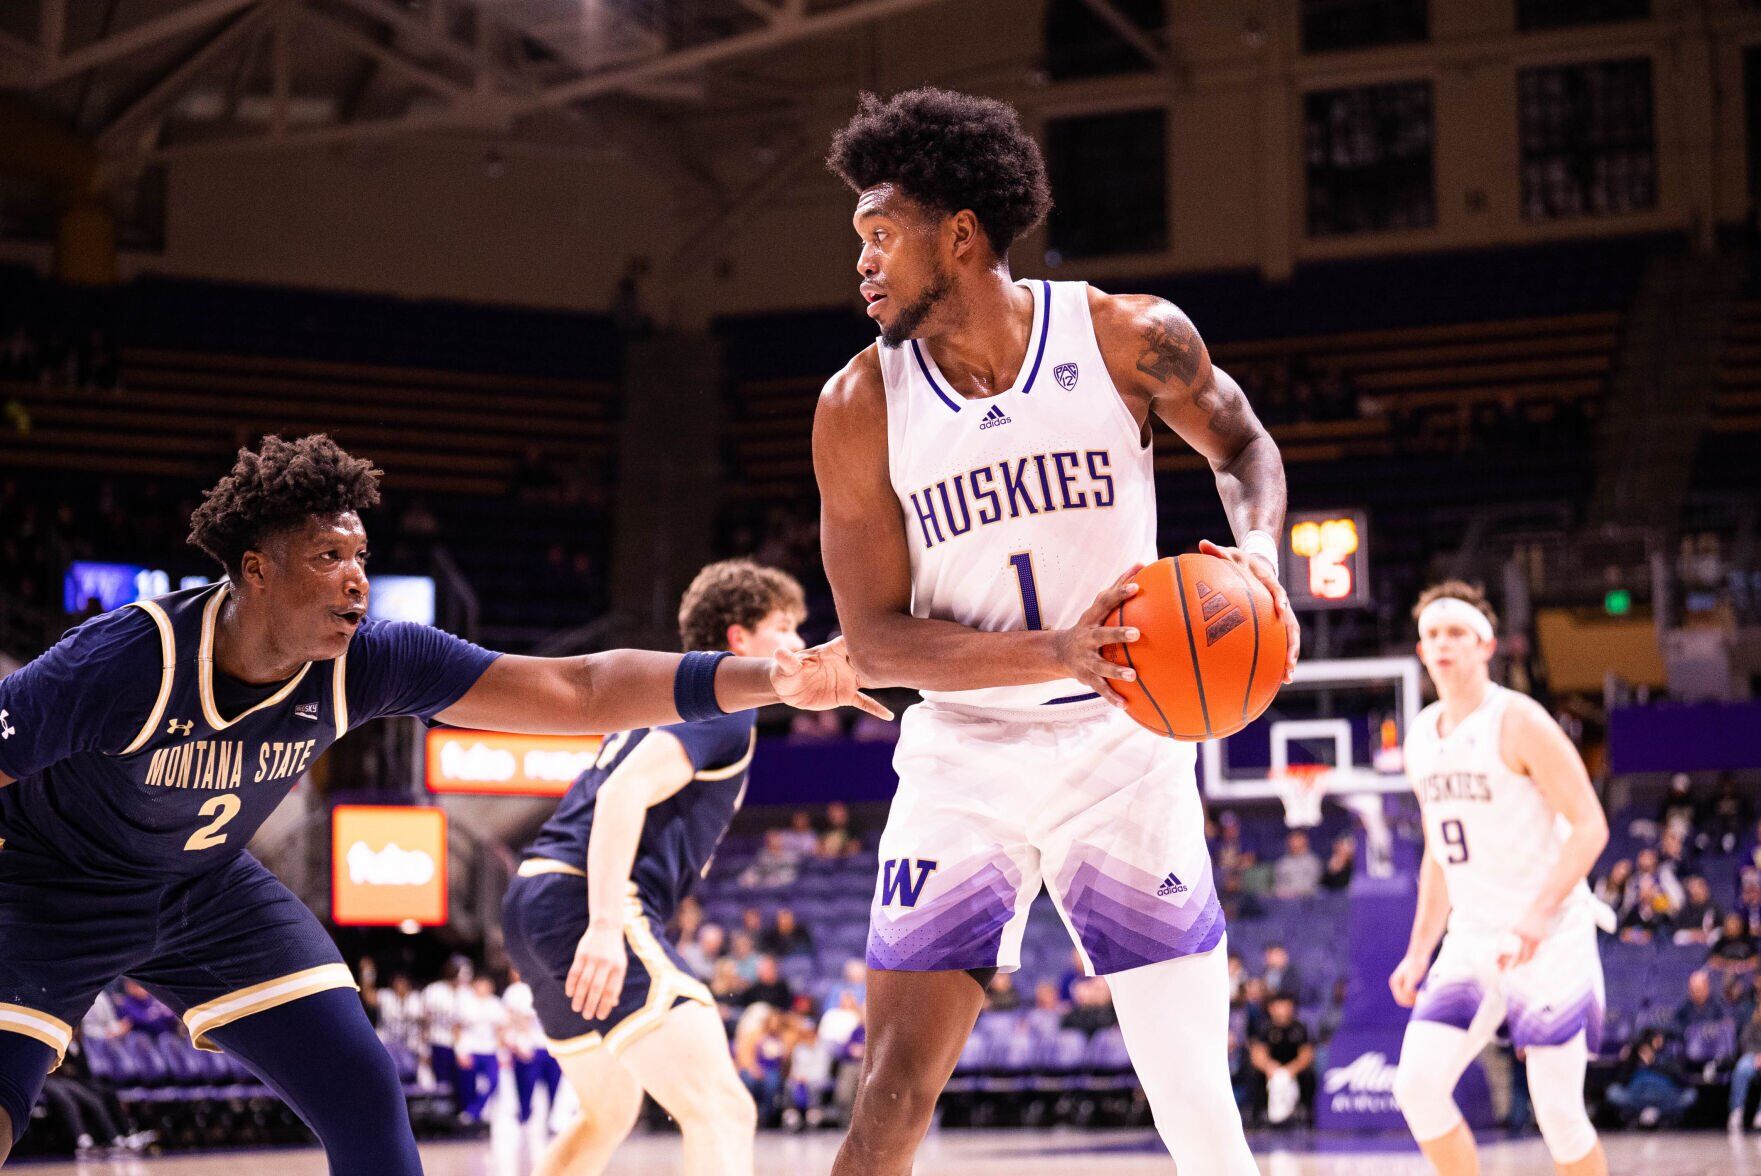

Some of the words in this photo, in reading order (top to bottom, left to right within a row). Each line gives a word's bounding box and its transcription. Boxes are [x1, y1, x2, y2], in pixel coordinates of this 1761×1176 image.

[1055, 364, 1077, 382] PAC
[1062, 375, 1075, 387] 12
[979, 416, 1012, 430] adidas
[909, 448, 1116, 549] HUSKIES
[1007, 550, 1044, 631] 1
[144, 739, 244, 790] MONTANA
[254, 738, 316, 783] STATE
[1418, 771, 1493, 803] USKIES
[183, 793, 242, 851] 2
[1441, 818, 1469, 864] 9
[881, 857, 939, 910] W
[1156, 884, 1188, 897] adidas
